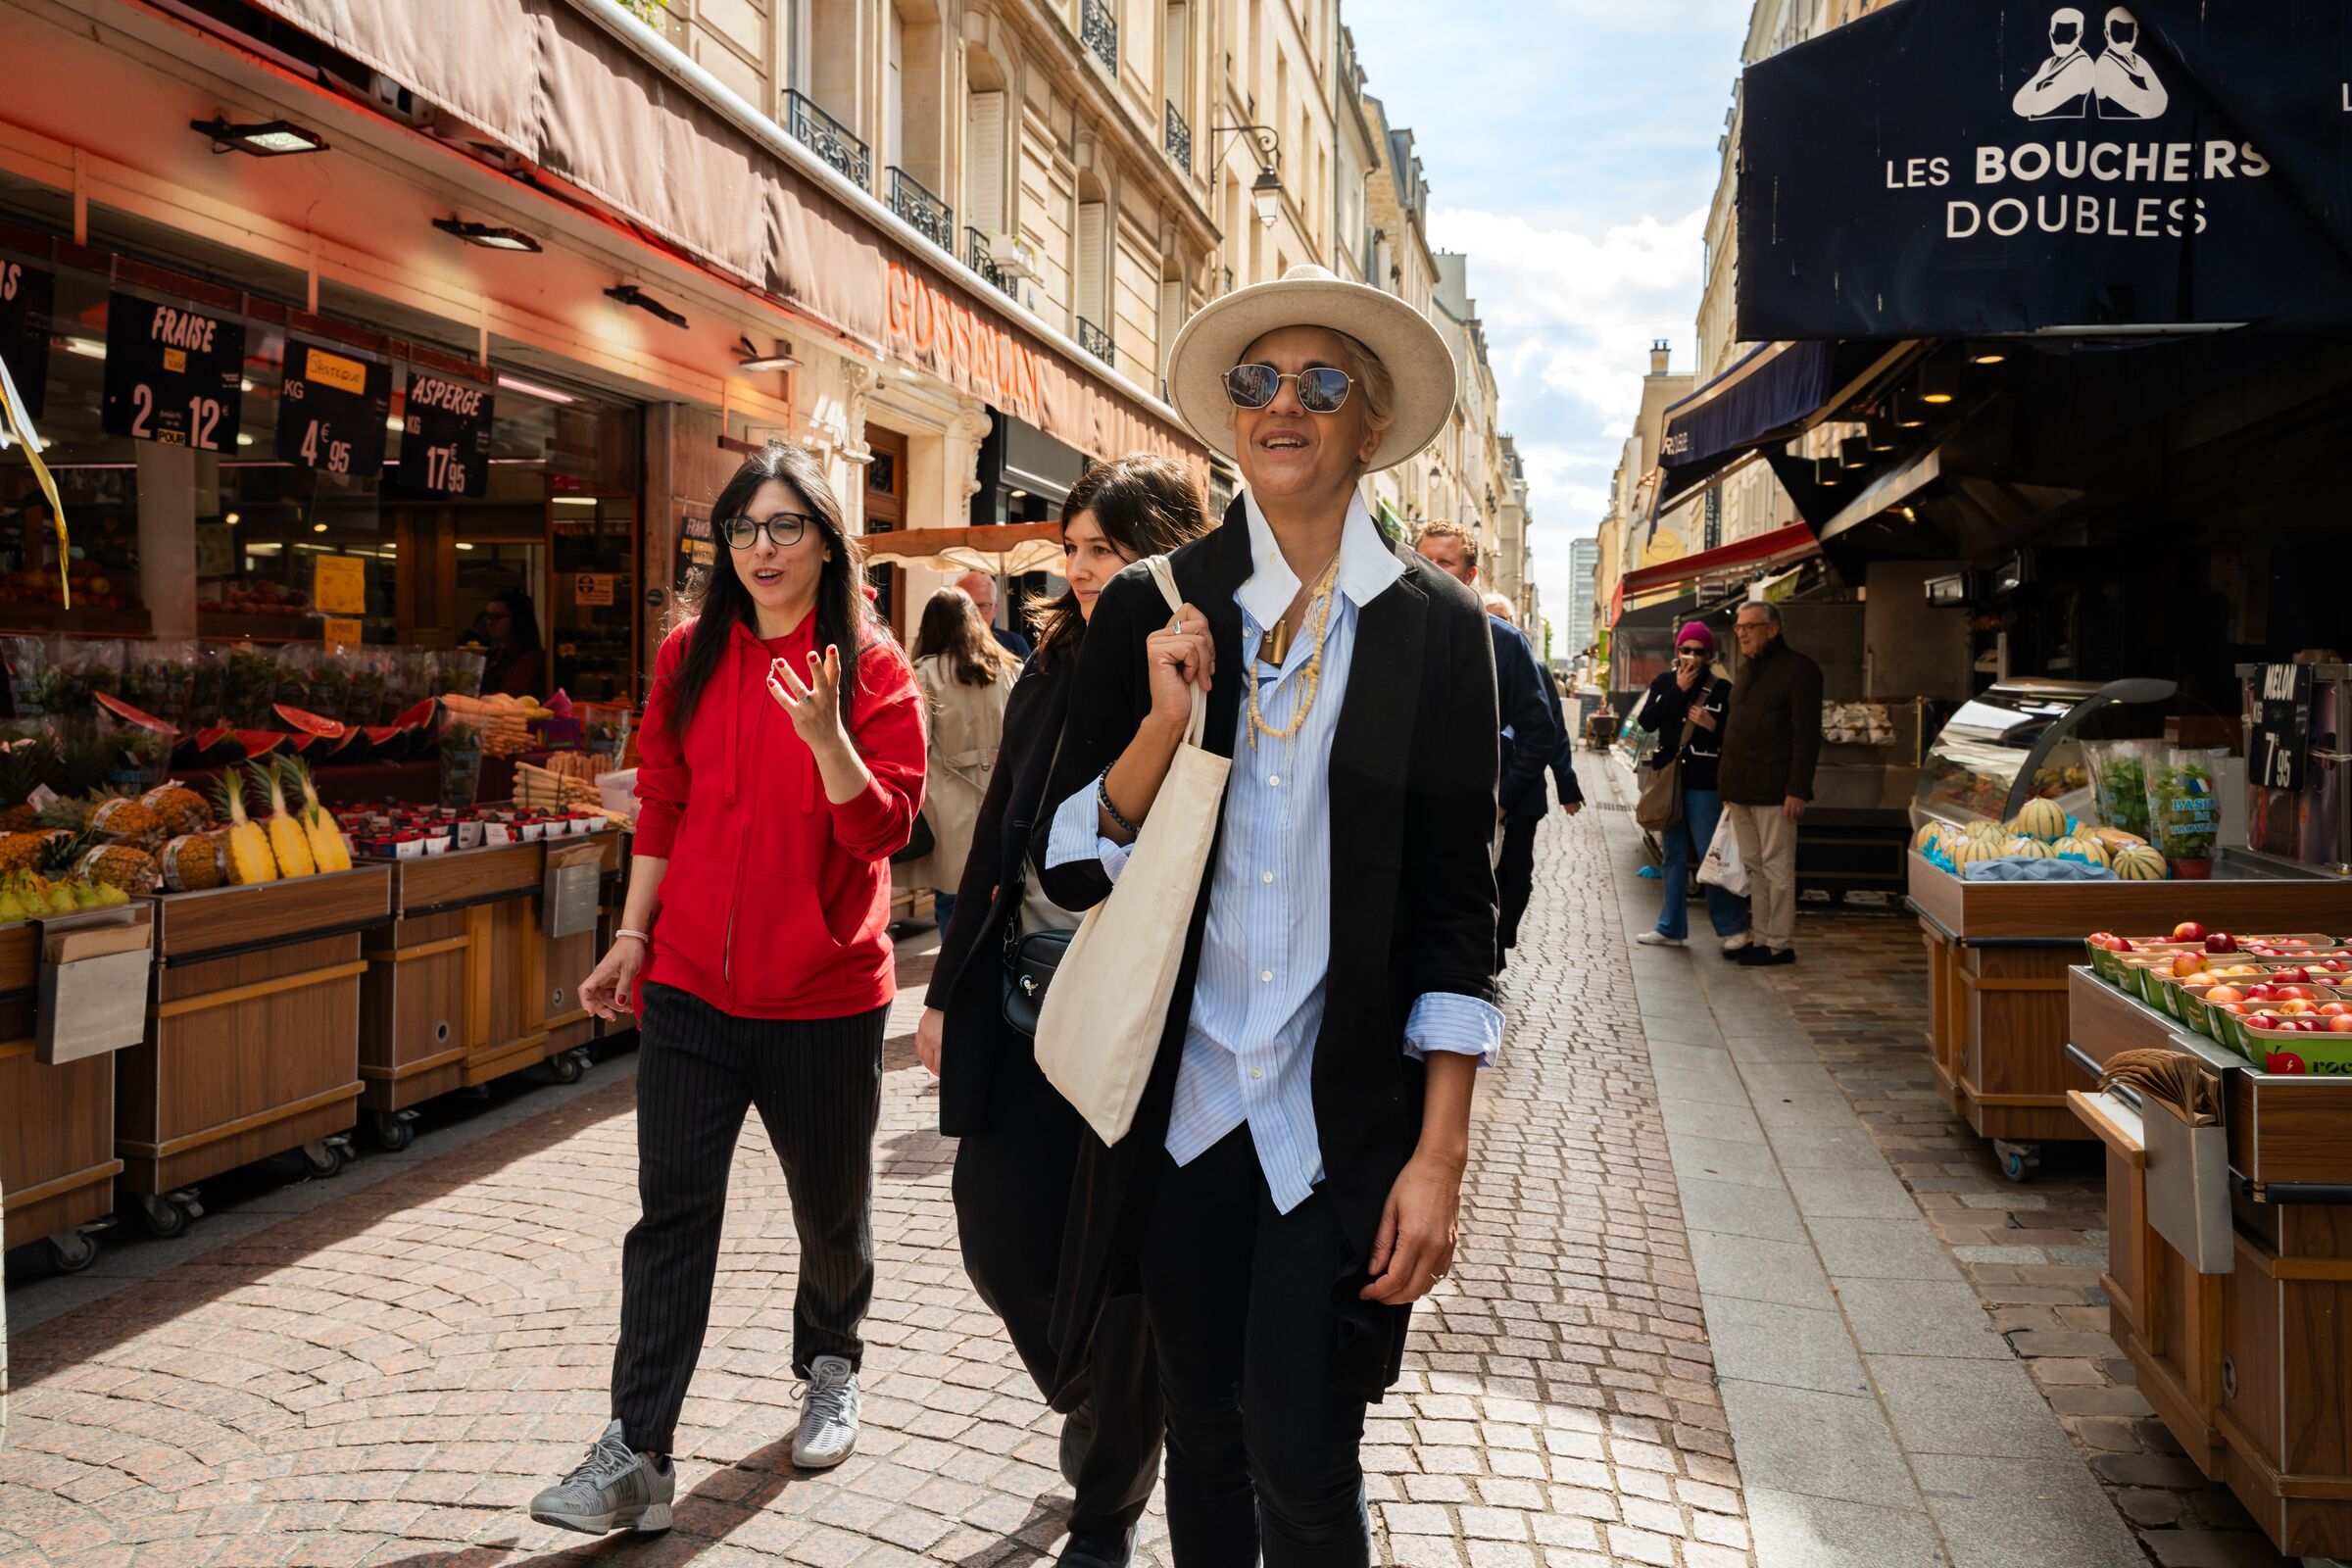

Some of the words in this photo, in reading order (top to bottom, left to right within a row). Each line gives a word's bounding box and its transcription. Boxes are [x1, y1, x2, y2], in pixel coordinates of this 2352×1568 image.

[1886, 157, 1950, 188] LES
[1976, 140, 2271, 184] BOUCHERS
[1946, 194, 2207, 238] DOUBLES
[151, 306, 217, 353] FRAISE
[284, 378, 303, 399] KG
[412, 375, 483, 416] ASPERGE
[131, 383, 153, 439] 2
[158, 430, 185, 444] POUR
[407, 415, 421, 435] KG
[2263, 663, 2297, 701] MELON
[2253, 701, 2263, 723] KG
